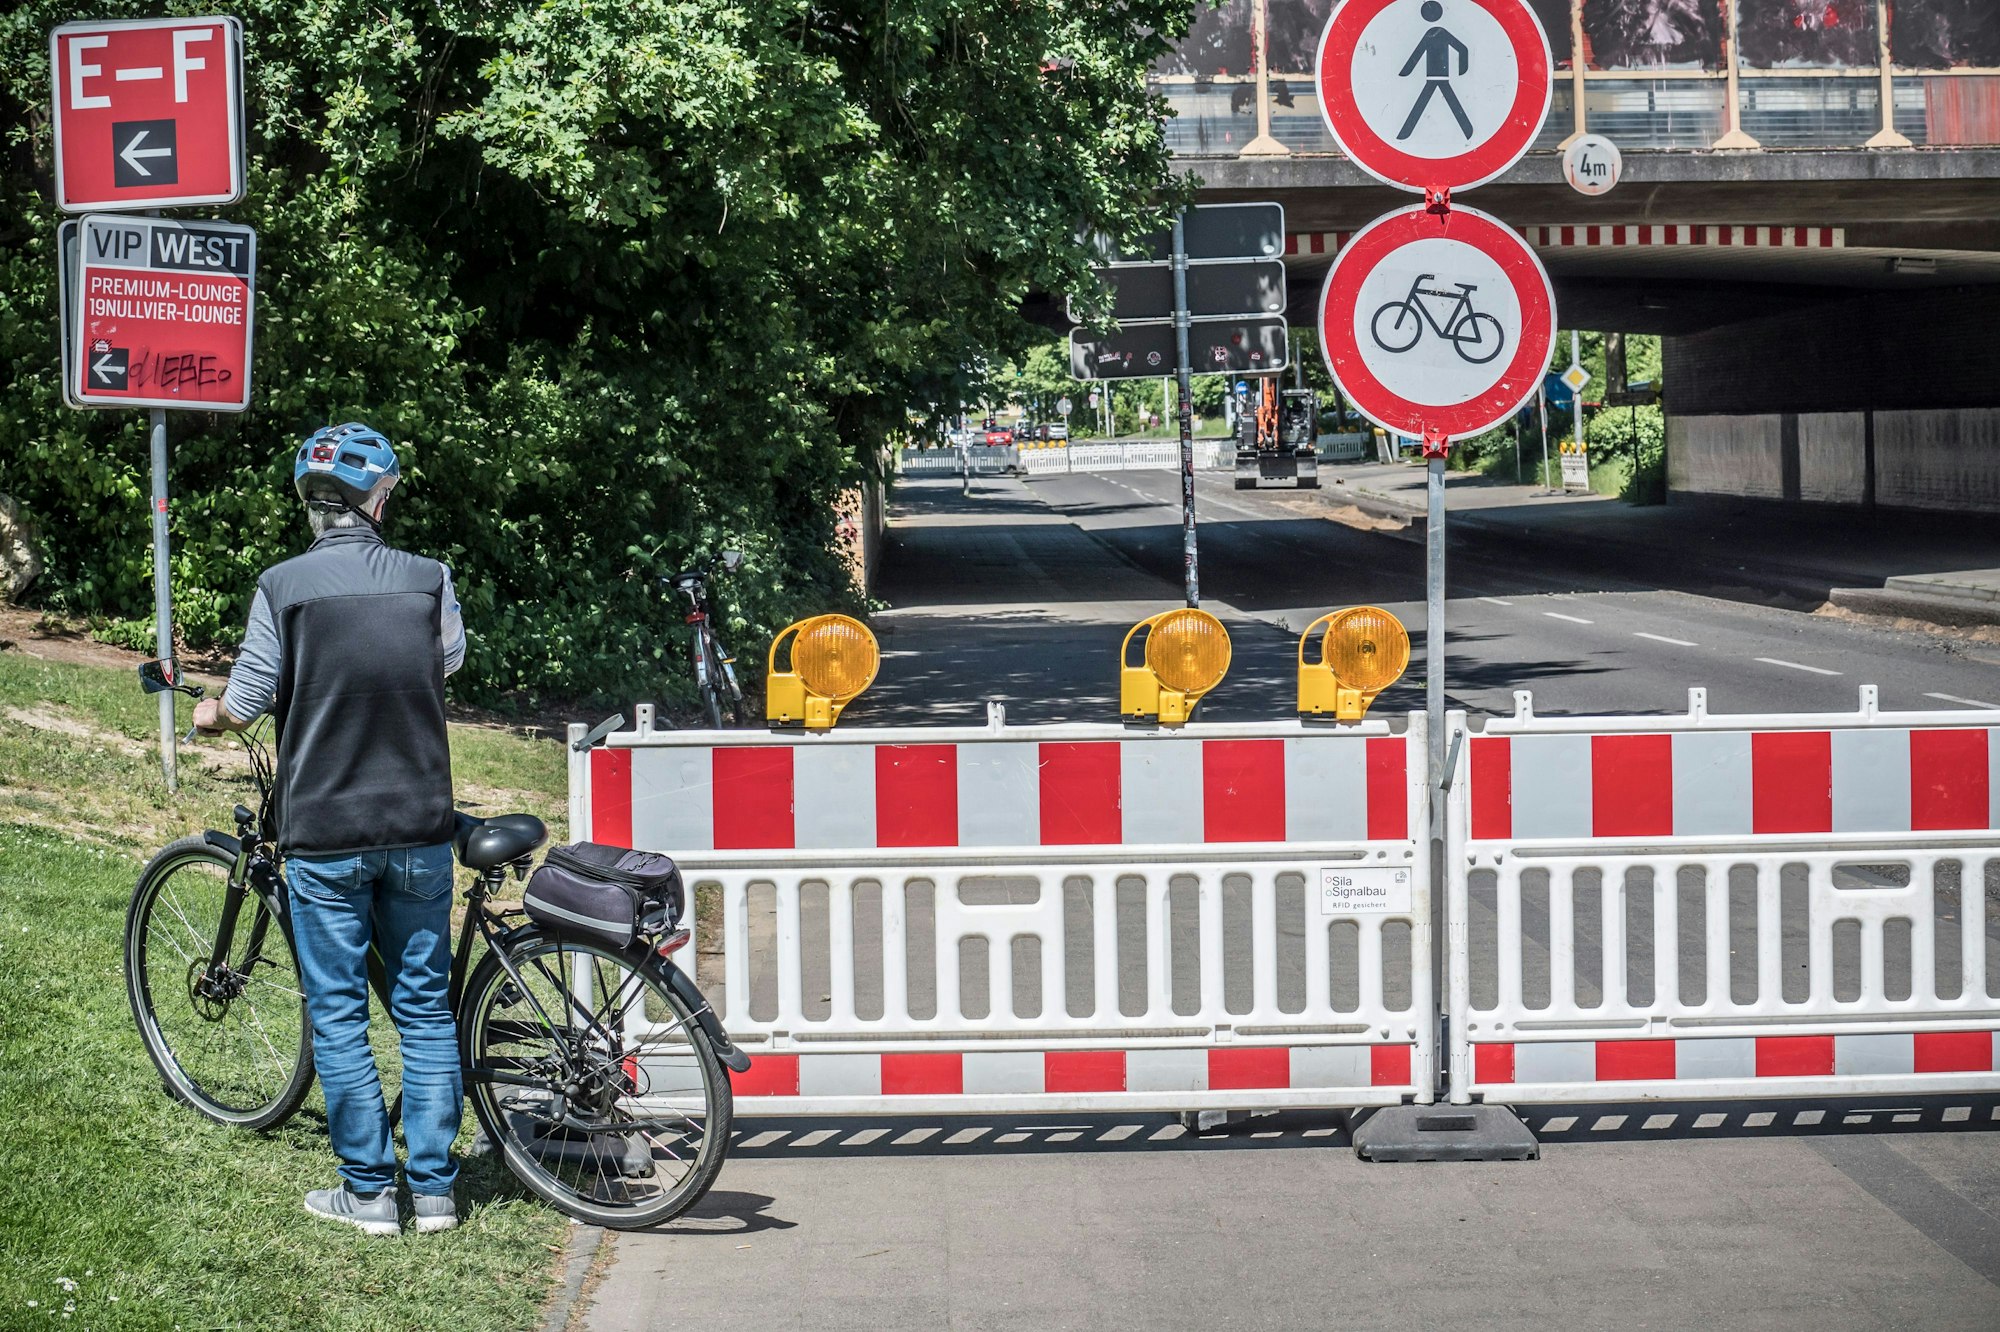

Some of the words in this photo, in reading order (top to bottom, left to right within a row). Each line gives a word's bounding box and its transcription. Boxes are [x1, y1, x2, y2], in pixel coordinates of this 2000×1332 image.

[1580, 153, 1607, 177] 4m
[93, 228, 142, 260] VIP
[156, 232, 245, 268] WEST
[91, 276, 242, 303] PREMIUM-LOUNGE
[89, 298, 242, 325] 19NULLVIER-LOUNGE
[1332, 876, 1353, 886] Sila
[1332, 886, 1387, 899] Signalbau
[1353, 901, 1386, 909] gesichert
